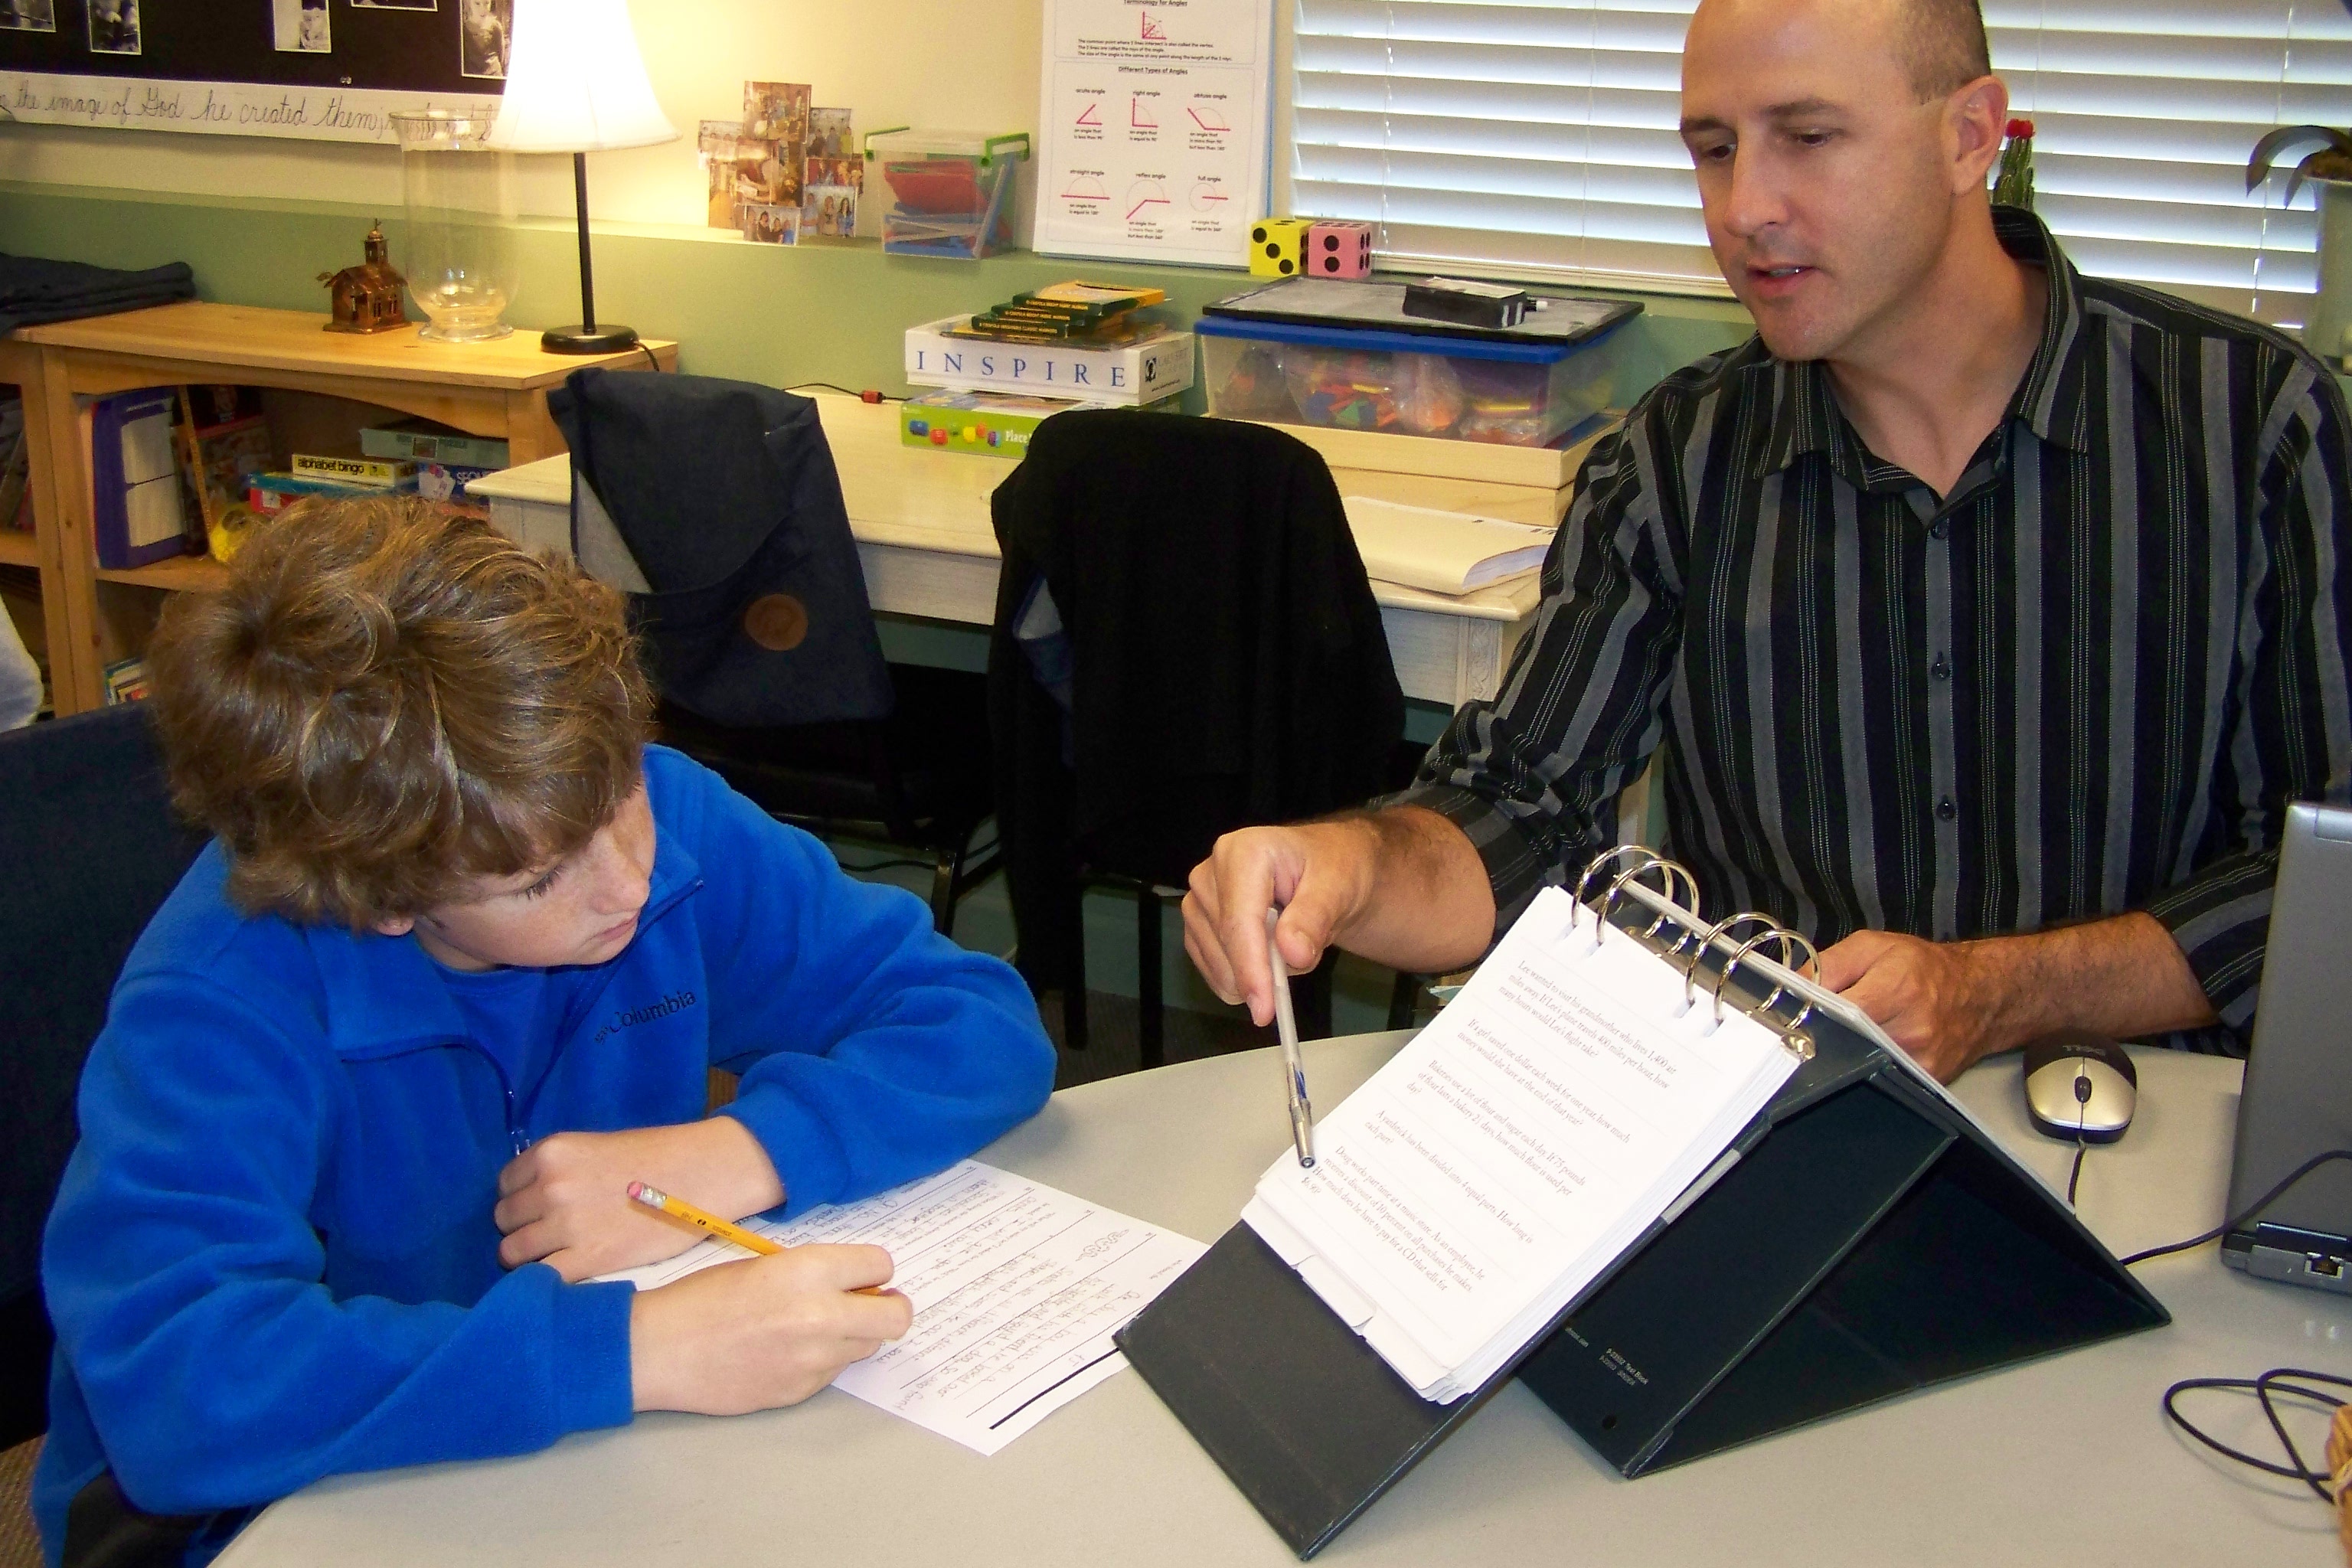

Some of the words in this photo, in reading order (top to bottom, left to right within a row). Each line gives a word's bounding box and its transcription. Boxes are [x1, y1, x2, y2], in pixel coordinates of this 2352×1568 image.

[14, 80, 39, 110] the
[44, 96, 107, 121] image
[113, 87, 131, 125] of
[136, 87, 185, 119] God
[191, 90, 232, 122] he
[240, 94, 308, 126] created
[916, 350, 1126, 387] INSPIRE
[1005, 430, 1028, 443] Place
[298, 459, 337, 473] alphabet
[338, 461, 364, 475] bingo
[610, 991, 697, 1033] Columbia
[1498, 987, 1515, 1001] many
[1514, 995, 1531, 1011] hours
[1531, 1009, 1552, 1024] would
[1549, 1020, 1566, 1035] Lee's
[1564, 1031, 1582, 1047] flight
[1581, 1044, 1599, 1057] take?
[1517, 960, 1530, 973] Lee
[1530, 971, 1553, 988] wanted
[1559, 991, 1572, 1001] visit
[1570, 997, 1581, 1008] his
[1578, 1007, 1620, 1035] grandmother
[1619, 1033, 1633, 1044] who
[1632, 1040, 1648, 1054] lives
[1648, 1050, 1668, 1067] 1,400
[1666, 1066, 1676, 1074] air
[1508, 975, 1524, 988] miles
[1539, 994, 1550, 1003] If
[1545, 998, 1561, 1014] Lee's
[1558, 1011, 1578, 1025] plane
[1577, 1023, 1597, 1038] travels
[1598, 1036, 1611, 1047] 400
[1609, 1046, 1626, 1059] miles
[1623, 1057, 1638, 1067] per
[1653, 1074, 1670, 1088] how
[1429, 1060, 1452, 1081] Bakeries
[1458, 1033, 1478, 1048] money
[1477, 1046, 1497, 1062] would
[1493, 1058, 1504, 1069] she
[1504, 1064, 1518, 1079] have
[1524, 1081, 1535, 1092] the
[1534, 1090, 1549, 1101] end
[1553, 1103, 1566, 1116] that
[1563, 1113, 1583, 1125] year?
[1468, 1019, 1478, 1027] If
[1476, 1029, 1491, 1038] girl
[1488, 1037, 1507, 1050] saved
[1504, 1048, 1515, 1058] one
[1514, 1055, 1533, 1070] dollar
[1531, 1069, 1547, 1081] each
[1546, 1078, 1563, 1093] week
[1560, 1089, 1571, 1099] for
[1570, 1098, 1583, 1108] one
[1596, 1115, 1612, 1129] how
[1610, 1128, 1630, 1143] much
[1407, 1083, 1422, 1094] day?
[1452, 1080, 1462, 1089] use
[1465, 1089, 1475, 1099] lot
[1480, 1101, 1495, 1115] flour
[1494, 1113, 1509, 1124] and
[1365, 1122, 1380, 1134] each
[1375, 1132, 1393, 1143] part?
[1424, 1076, 1439, 1090] flour
[1437, 1086, 1451, 1099] lasts
[1453, 1099, 1472, 1119] bakery
[1495, 1132, 1510, 1145] how
[1508, 1145, 1527, 1160] much
[1524, 1156, 1541, 1171] flour
[1546, 1174, 1563, 1187] used
[1557, 1186, 1572, 1195] per
[1505, 1122, 1522, 1135] sugar
[1521, 1135, 1537, 1147] each
[1547, 1152, 1558, 1161] If
[1553, 1158, 1566, 1168] 75
[1324, 1158, 1344, 1178] receives
[1380, 1117, 1407, 1138] yardstick
[1405, 1134, 1416, 1145] has
[1415, 1142, 1429, 1157] been
[1429, 1155, 1453, 1174] divided
[1449, 1173, 1462, 1184] into
[1465, 1187, 1485, 1201] equal
[1496, 1210, 1514, 1227] How
[1512, 1223, 1527, 1240] long
[1559, 1167, 1586, 1185] pounds
[1348, 1178, 1372, 1201] discount
[1335, 1146, 1352, 1165] Doug
[1351, 1161, 1367, 1176] works
[1363, 1176, 1380, 1187] part
[1378, 1185, 1392, 1198] time
[1400, 1206, 1418, 1222] music
[1431, 1232, 1441, 1242] As
[1475, 1269, 1485, 1280] he
[1377, 1204, 1387, 1214] 10
[1312, 1166, 1328, 1181] How
[1325, 1181, 1343, 1196] much
[1341, 1193, 1354, 1207] does
[1360, 1210, 1374, 1225] have
[1377, 1230, 1391, 1241] pay
[1390, 1237, 1400, 1247] for
[1403, 1248, 1416, 1260] CD
[1413, 1259, 1426, 1272] that
[1426, 1270, 1439, 1282] sells
[1436, 1280, 1447, 1290] for
[1381, 1212, 1406, 1231] percent
[1416, 1243, 1446, 1268] purchases
